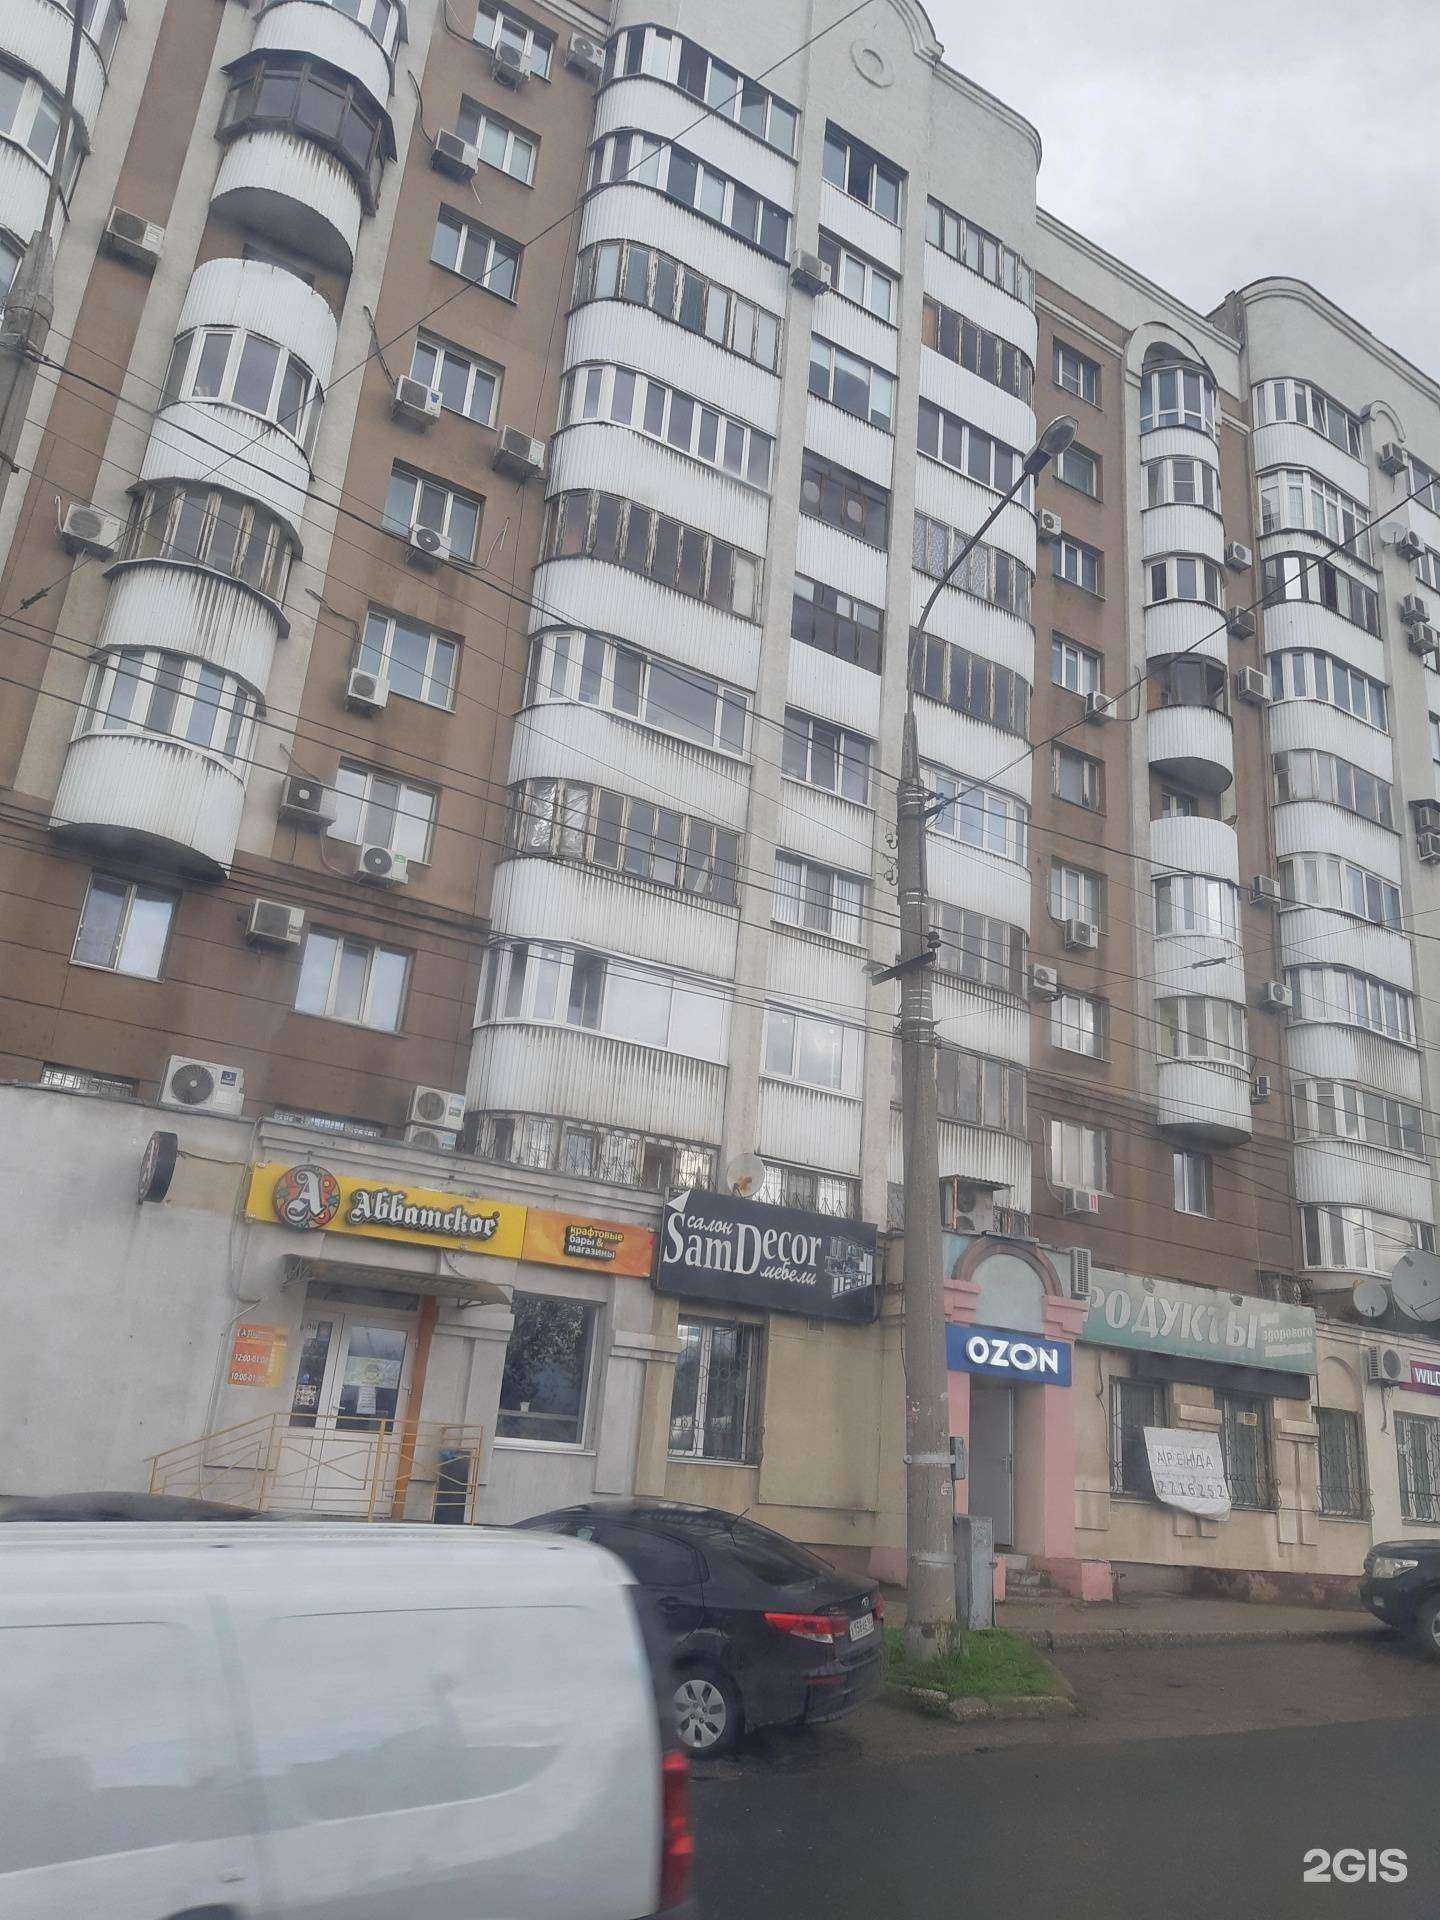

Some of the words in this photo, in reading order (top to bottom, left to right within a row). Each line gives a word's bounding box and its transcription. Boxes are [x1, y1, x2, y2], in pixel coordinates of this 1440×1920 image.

[350, 1191, 499, 1236] Аббатское
[570, 1225, 624, 1242] крафтовые
[687, 1215, 733, 1235] салон
[569, 1233, 595, 1248] бары
[596, 1238, 605, 1248] &
[568, 1244, 616, 1259] магазины
[759, 1260, 817, 1285] мебели
[1088, 1286, 1258, 1350] РОДУКТЫ
[1263, 1327, 1313, 1343] здорового
[966, 1336, 1058, 1374] OZON
[1157, 1449, 1214, 1469] АРЕНДА
